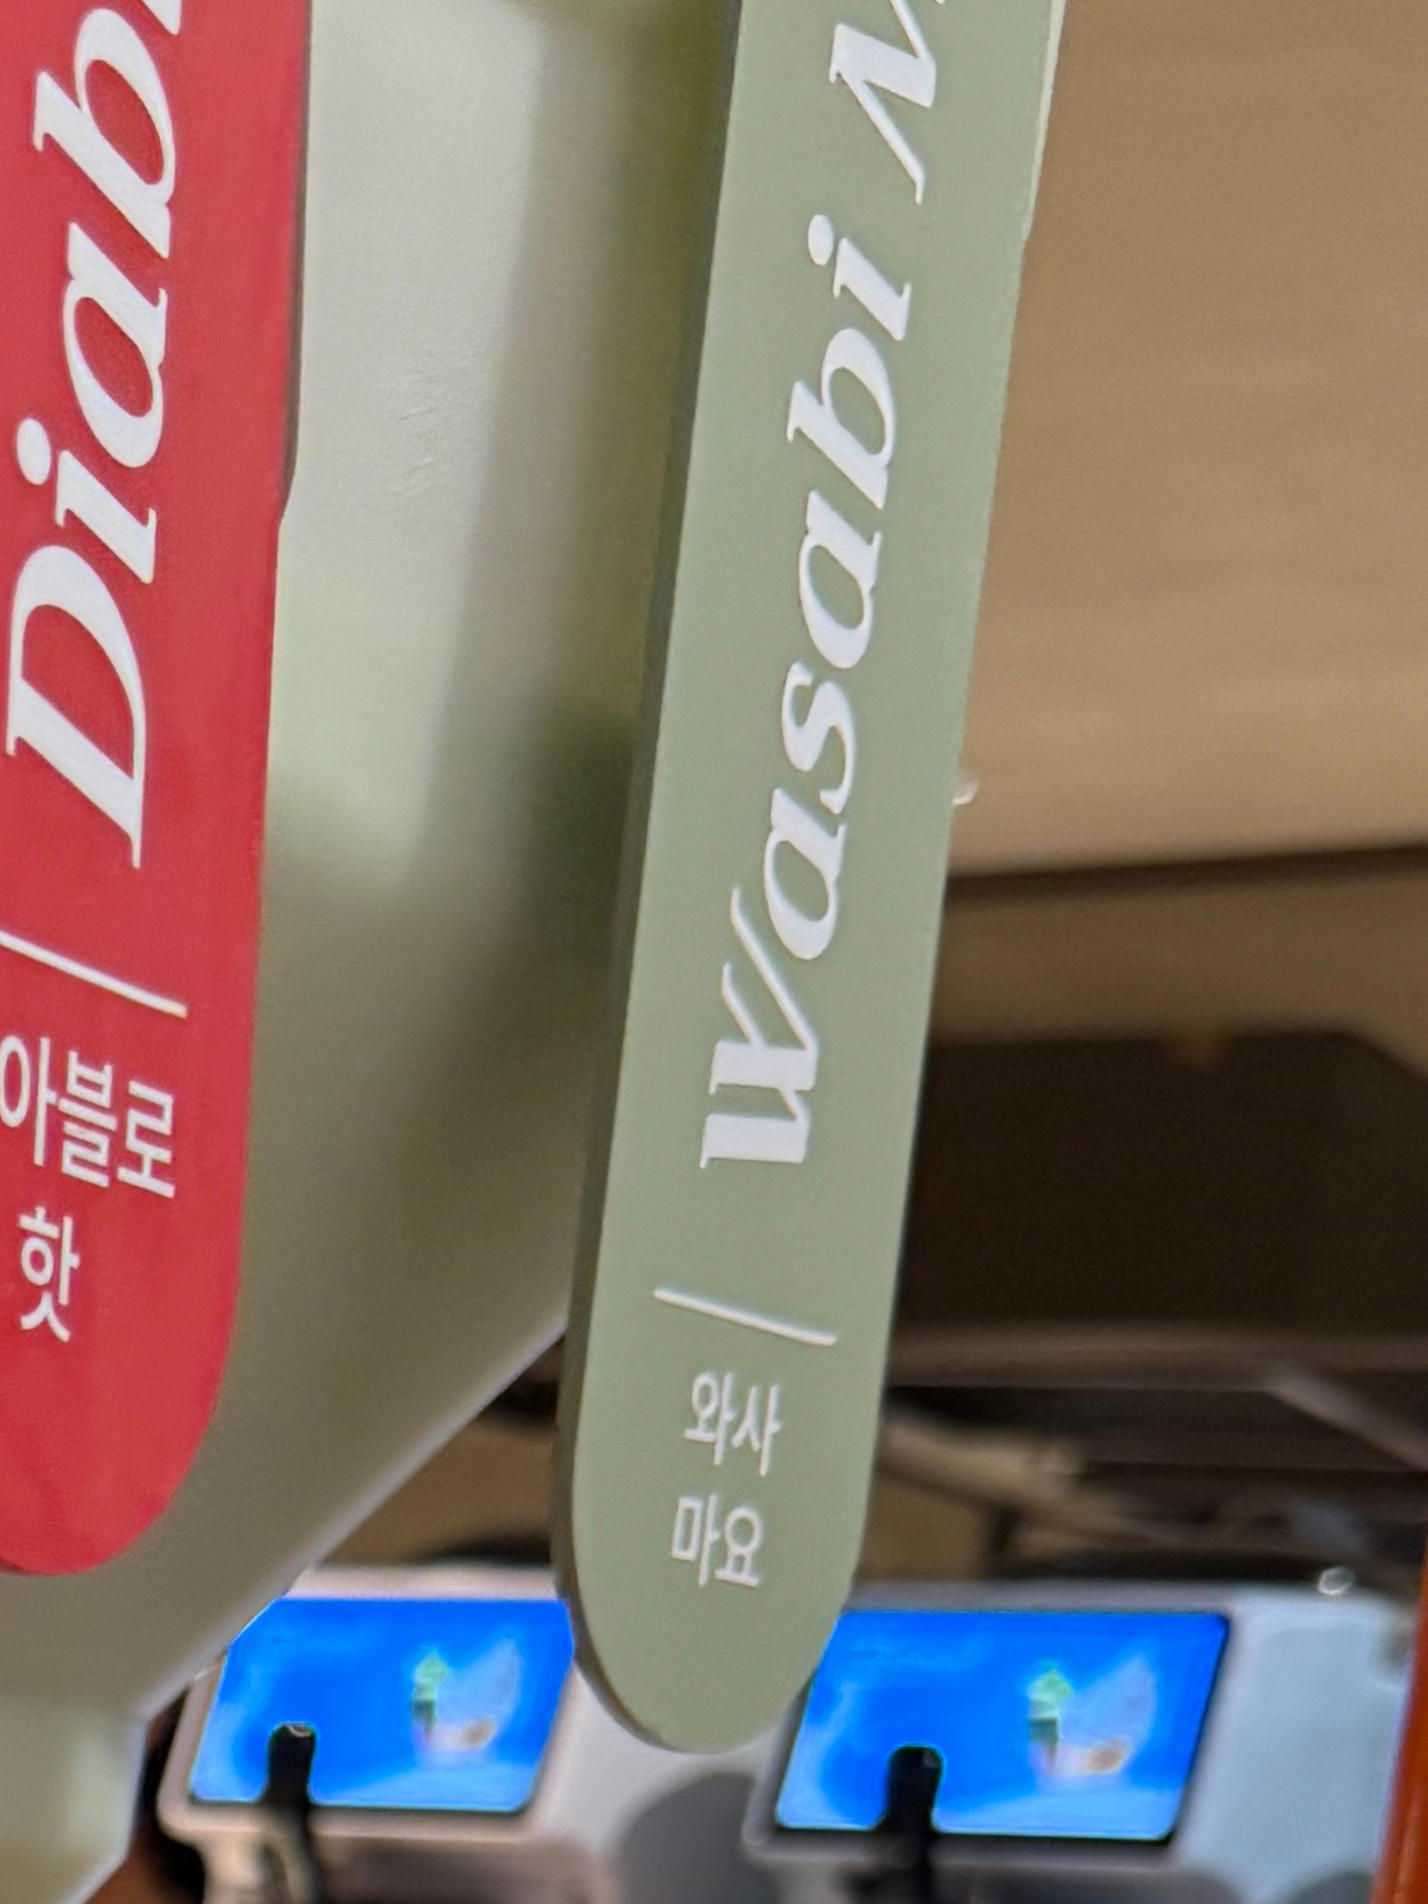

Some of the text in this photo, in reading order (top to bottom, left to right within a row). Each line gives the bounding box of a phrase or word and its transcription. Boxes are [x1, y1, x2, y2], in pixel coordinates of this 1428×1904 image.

[6, 0, 183, 870] Diab
[700, 213, 912, 1170] Wasabi
[17, 1205, 80, 1343] 핫
[683, 1370, 782, 1477] 와사
[670, 1492, 763, 1587] 마요
